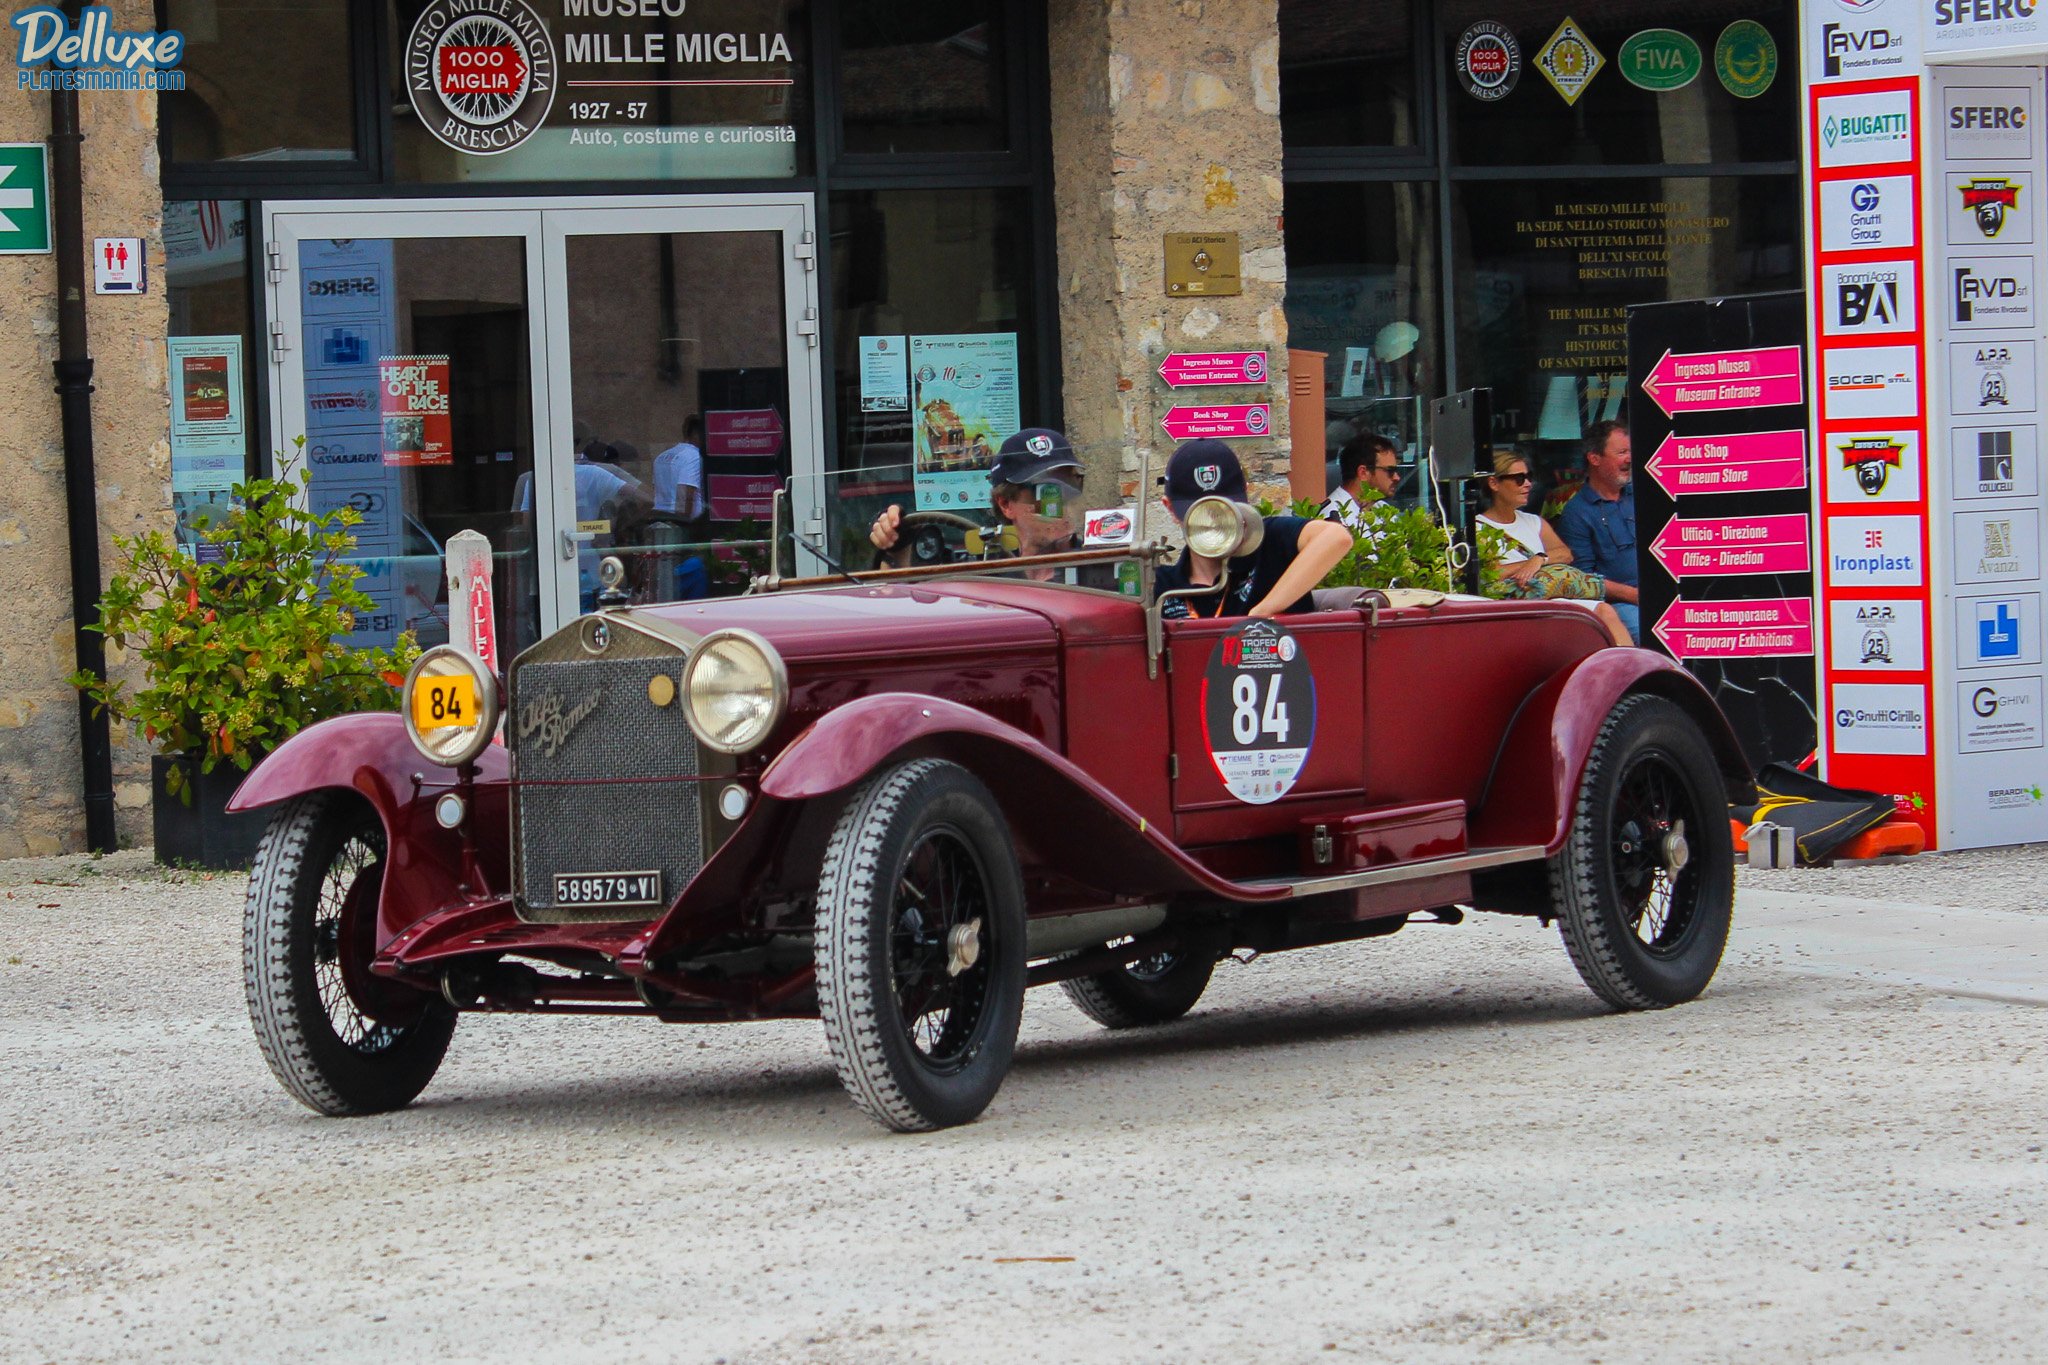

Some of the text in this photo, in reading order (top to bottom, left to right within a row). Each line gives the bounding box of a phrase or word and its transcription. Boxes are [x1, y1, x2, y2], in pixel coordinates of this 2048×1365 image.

[563, 0, 686, 17] MUSEO
[411, 0, 551, 93] MUSEO MILLE MIGLIA
[564, 33, 793, 63] MILLE MIGLIA
[1457, 24, 1519, 72] MUSEO MILLE MIGLIA
[448, 51, 504, 67] 1000
[1473, 52, 1499, 61] 1000
[1635, 48, 1686, 71] FIVA
[1472, 62, 1501, 72] MIGLIA
[446, 72, 510, 89] MIGLIA
[1470, 84, 1510, 99] BRESCIA
[568, 102, 610, 120] 1927
[627, 102, 648, 119] 57
[440, 115, 529, 149] BRESCIA
[1840, 113, 1906, 136] BUGATTI
[569, 124, 797, 147] Auto, costume e curiosità
[1555, 204, 1567, 215] IL
[1570, 204, 1609, 215] MUSEO
[1611, 203, 1648, 214] MILLE
[1516, 221, 1533, 233] HA
[1535, 220, 1565, 232] SEDE
[1566, 219, 1605, 231] NELLO
[1606, 219, 1657, 231] STORICO
[1851, 213, 1881, 226] Gnutti
[1535, 237, 1549, 248] DI
[1549, 235, 1634, 248] SANT'EUFEMIA
[1636, 234, 1671, 246] DELLA
[1851, 227, 1881, 240] Group
[1625, 251, 1671, 262] SECOLO
[1578, 268, 1627, 280] BRESCIA
[1635, 266, 1672, 278] ITALIA
[1838, 272, 1870, 285] Bonomi
[1549, 308, 1572, 320] THE
[1574, 307, 1611, 319] MILLE
[1578, 324, 1600, 336] IT'S
[1565, 339, 1620, 352] HISTORIC
[1183, 357, 1234, 368] Ingresso Museo
[1538, 355, 1628, 369] OF SANT'EUFEM
[1975, 348, 2011, 361] A.P.R.
[381, 366, 428, 382] HEART
[1179, 371, 1239, 381] Museum Entrance
[1674, 358, 1750, 380] Ingresso Museo
[387, 380, 439, 396] OF THE
[1829, 374, 1885, 386] socar
[1675, 383, 1762, 403] Museum Entrance
[1987, 380, 2001, 397] 25
[407, 394, 449, 410] RACE
[1193, 411, 1229, 421] Book Shop
[1188, 424, 1235, 433] Museum Store
[1677, 442, 1729, 460] Book Shop
[1679, 468, 1749, 485] Museum Store
[1682, 526, 1713, 542] Ufficio
[1721, 524, 1768, 540] Direzione
[1682, 552, 1711, 568] Office
[1718, 549, 1764, 566] Direction
[1835, 554, 1911, 575] Ironplast
[1977, 557, 2019, 575] Avanzi
[470, 574, 490, 661] MILLE
[1684, 606, 1779, 625] Mostre temporanee
[1856, 606, 1896, 619] A.P.R.
[1241, 639, 1277, 647] TROFEO
[1685, 630, 1793, 652] Temporary Exhibitions
[1868, 638, 1884, 655] 25
[431, 686, 462, 721] 84
[1232, 673, 1291, 746] 84
[518, 688, 564, 749] Alfa
[541, 688, 599, 757] Romeo
[1988, 788, 2023, 798] BERARDI
[558, 876, 656, 901] 589579 VI
